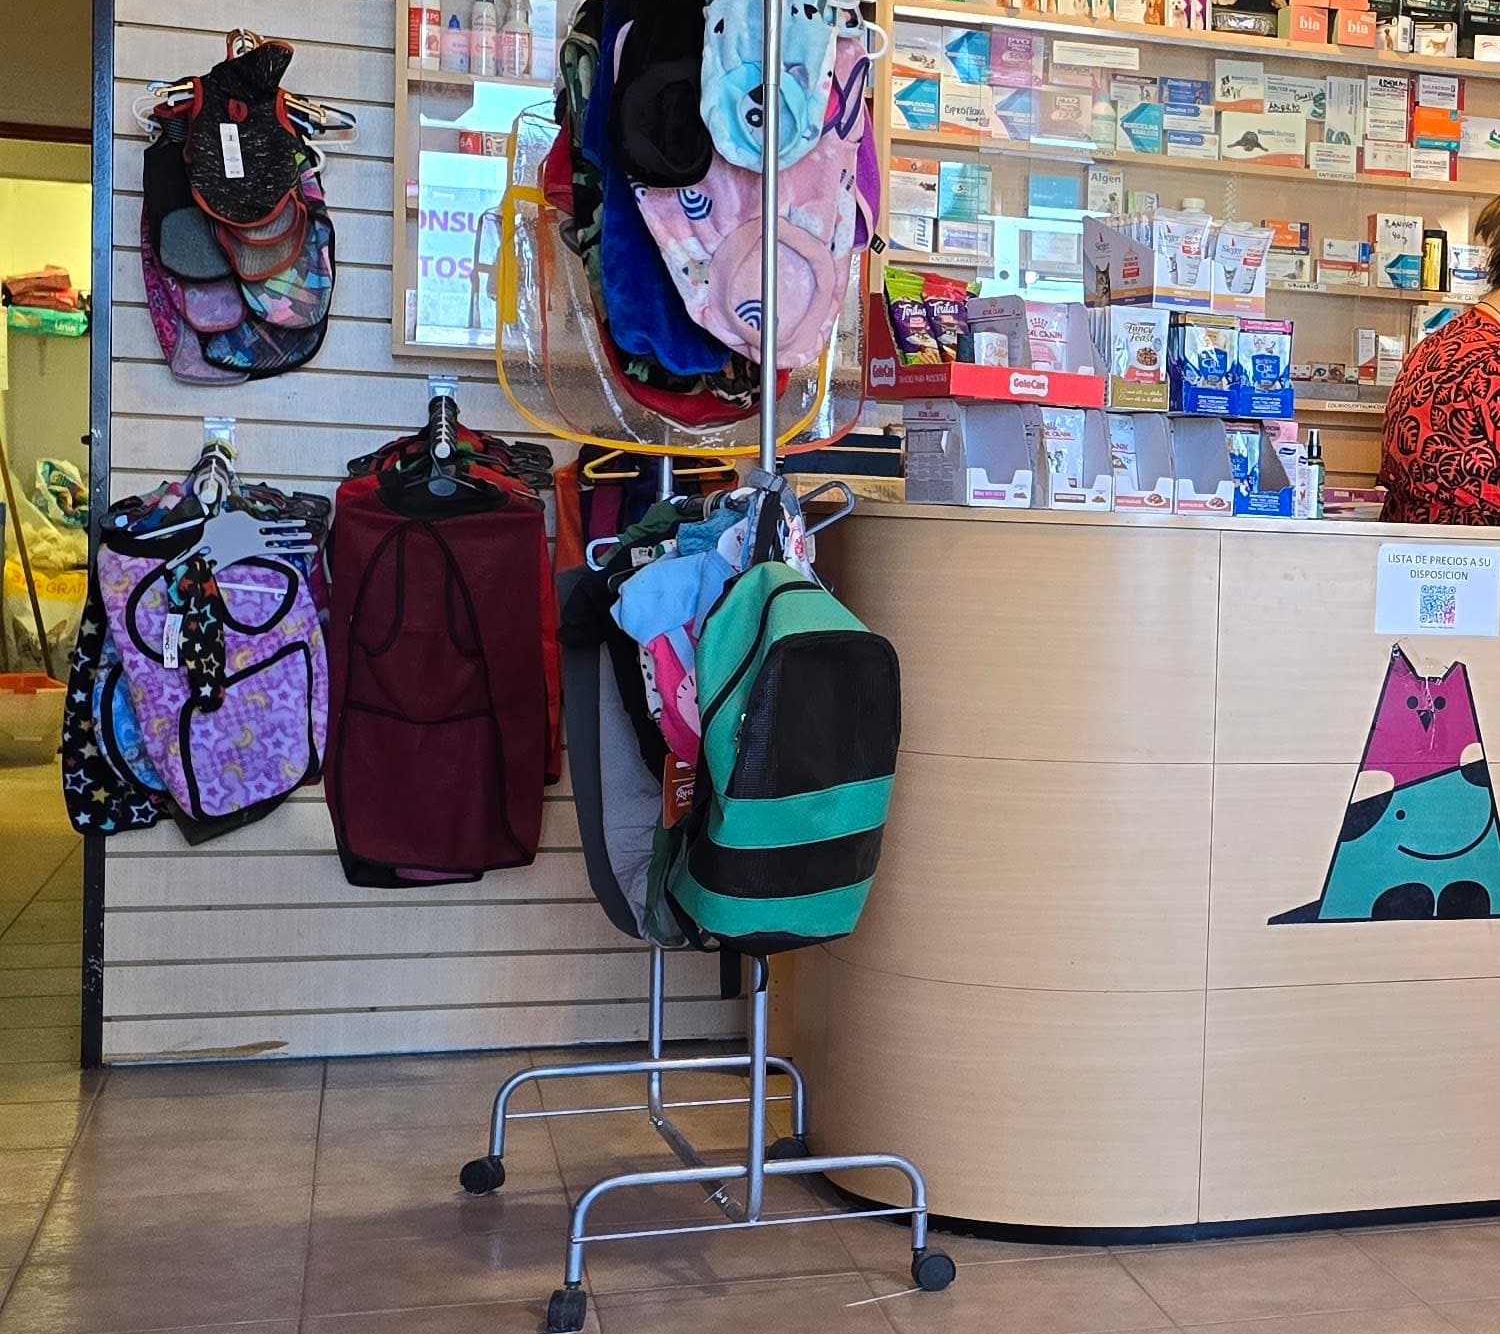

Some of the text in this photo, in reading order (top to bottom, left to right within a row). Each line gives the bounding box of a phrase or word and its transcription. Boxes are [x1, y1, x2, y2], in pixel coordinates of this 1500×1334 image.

[1299, 17, 1321, 31] bia
[1346, 20, 1369, 34] bia
[1090, 172, 1122, 185] Algen
[1013, 378, 1046, 391] GoloCan
[1387, 554, 1491, 567] LISTA DE PRECIOS A SU
[1409, 569, 1469, 581] DISPOSICION
